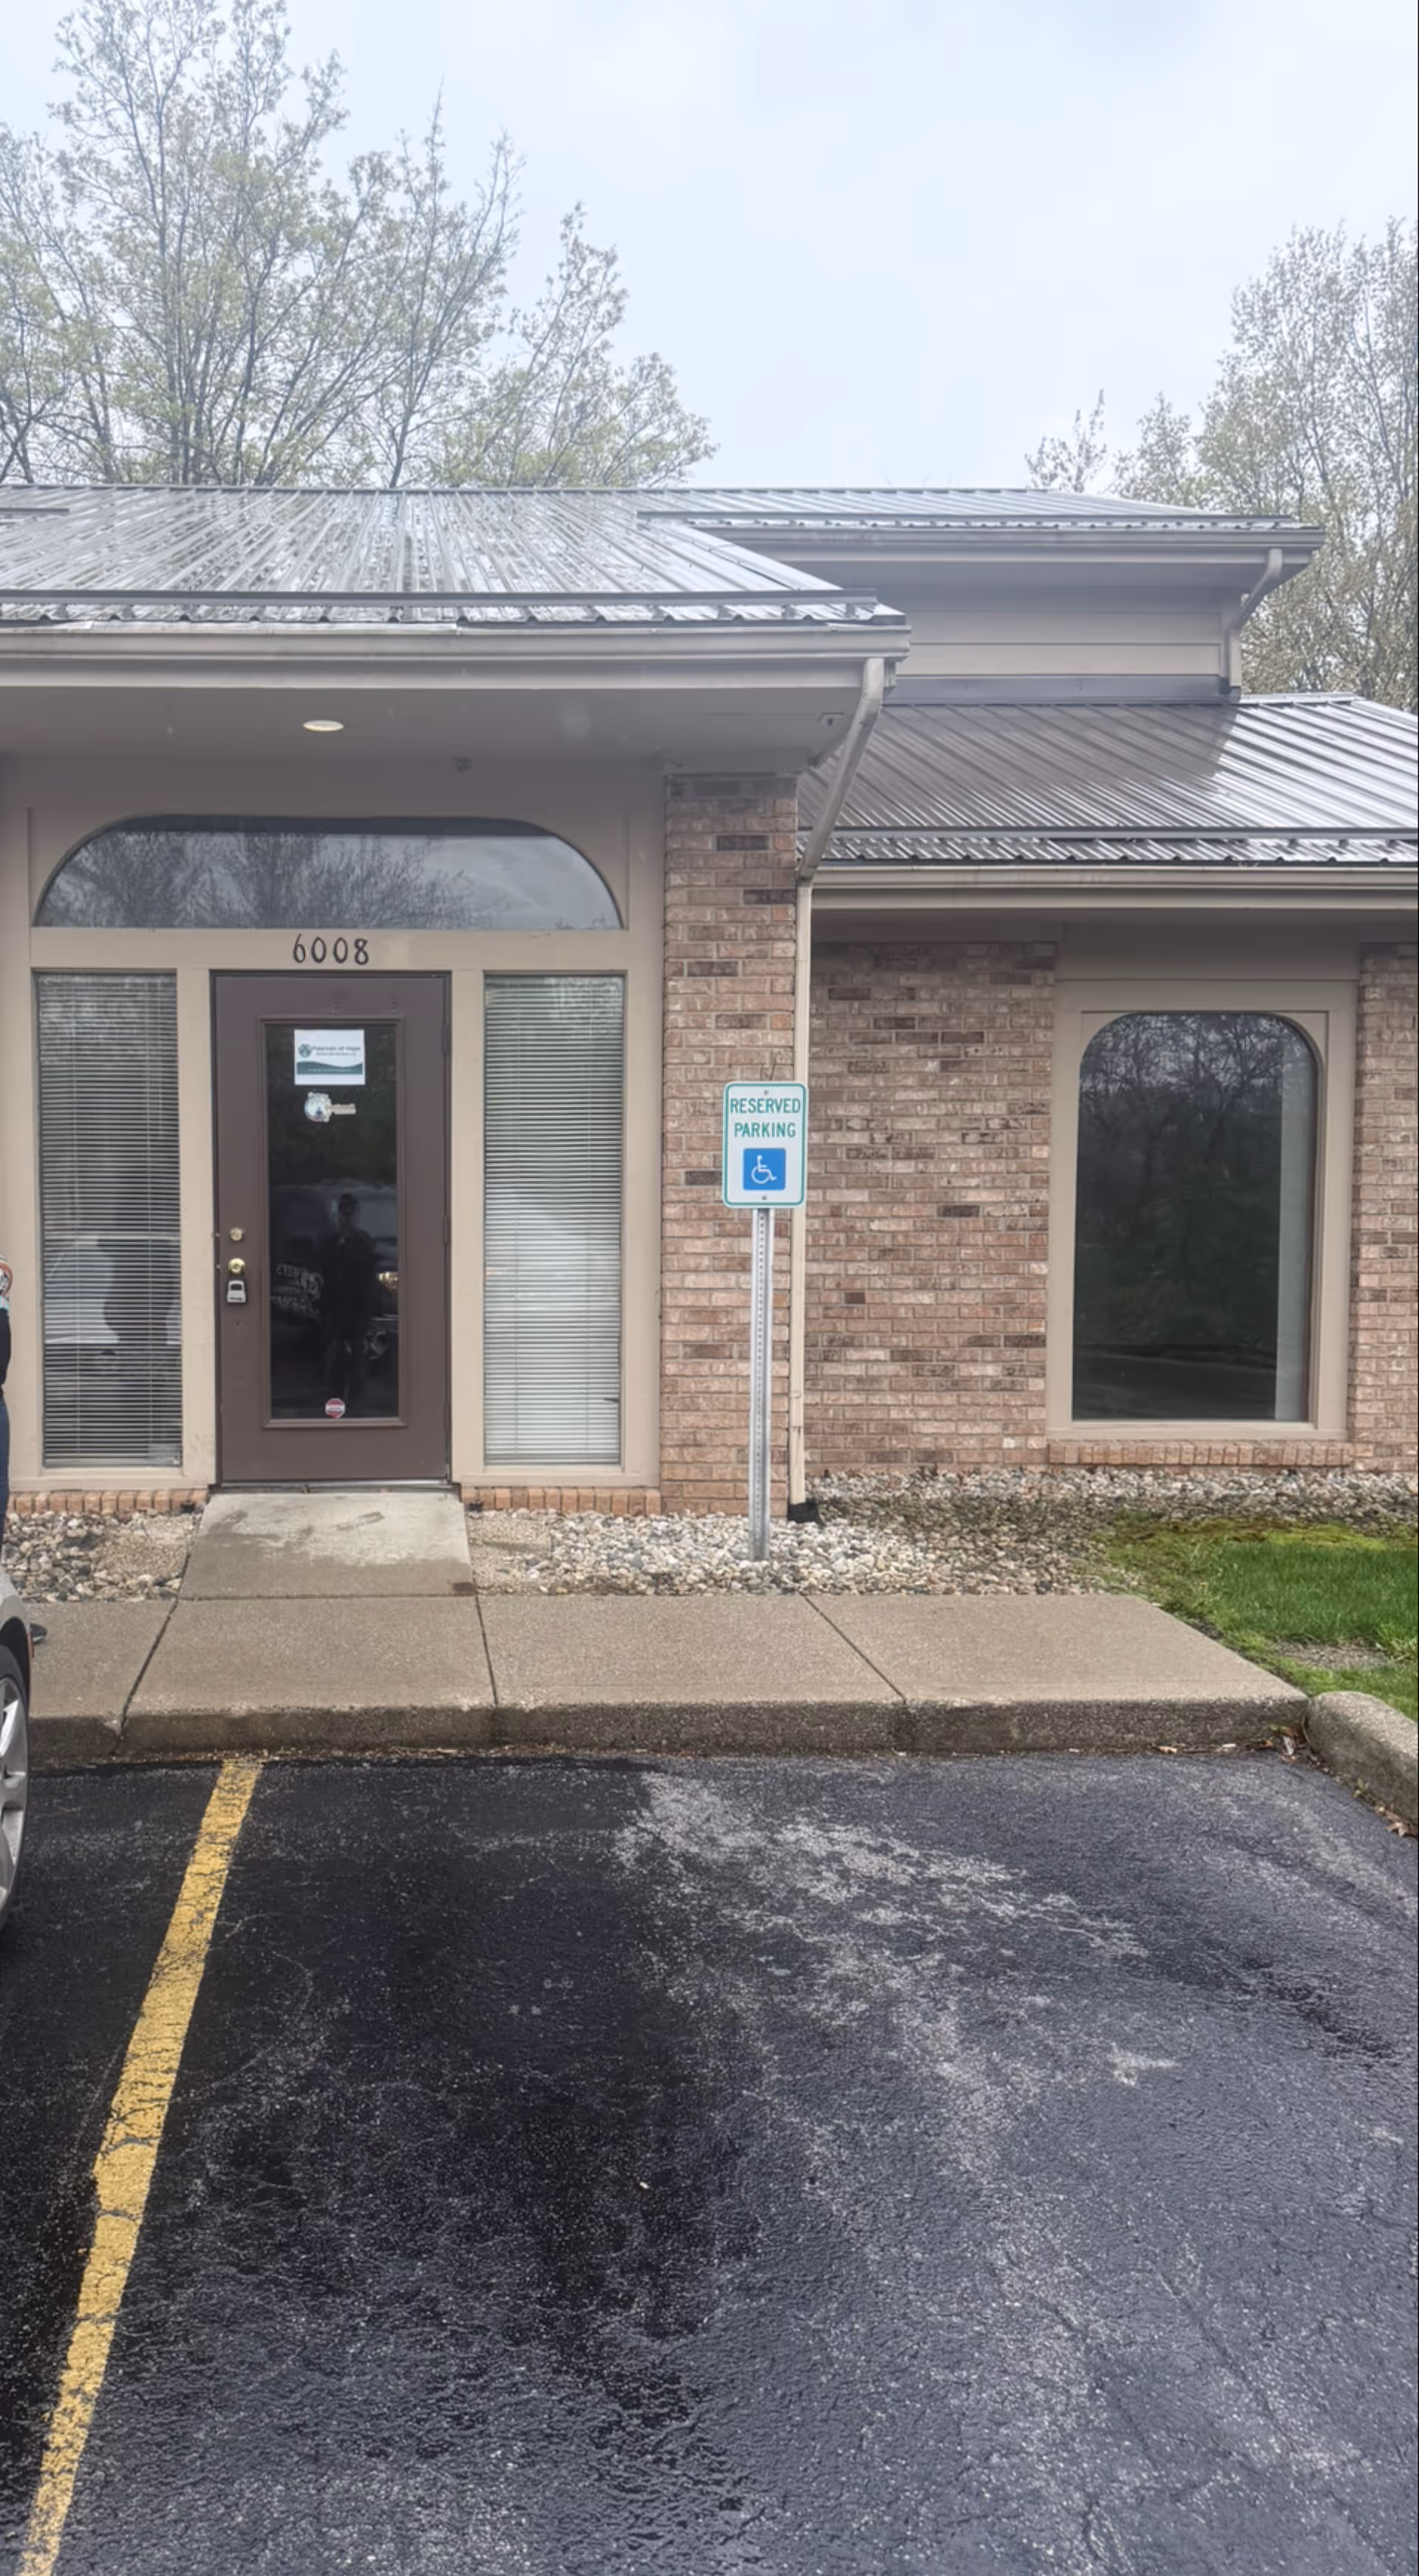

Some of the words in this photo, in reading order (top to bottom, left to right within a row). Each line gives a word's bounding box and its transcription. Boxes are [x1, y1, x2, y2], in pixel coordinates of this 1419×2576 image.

[293, 933, 369, 965] 6008
[730, 1098, 800, 1114] RESERVED
[734, 1122, 796, 1138] PARKING
